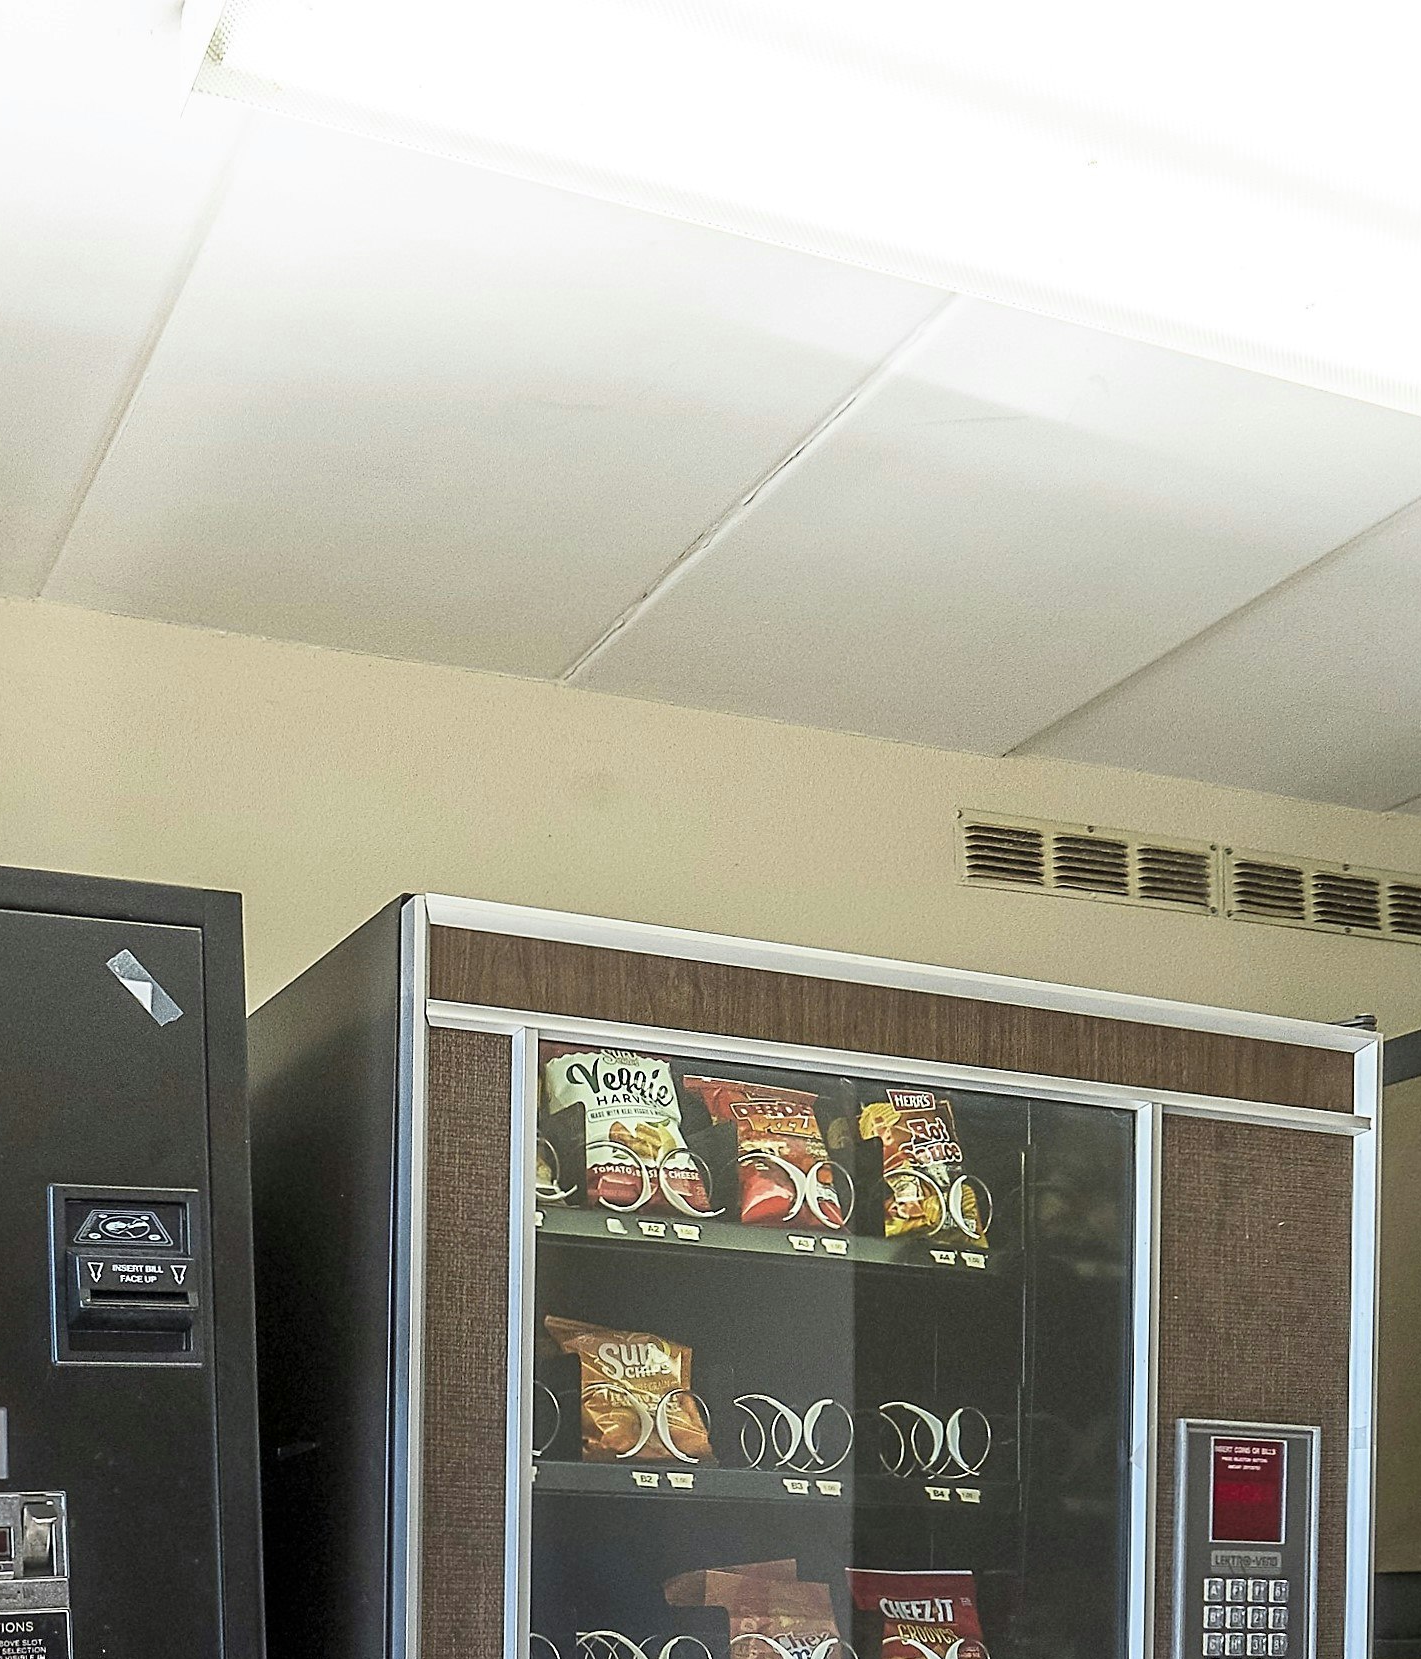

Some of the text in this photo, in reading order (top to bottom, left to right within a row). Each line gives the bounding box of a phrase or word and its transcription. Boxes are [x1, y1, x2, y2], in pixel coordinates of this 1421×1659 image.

[566, 1058, 674, 1106] Veggie
[894, 1094, 931, 1108] HERR'S
[669, 1170, 700, 1180] CHEESE
[647, 1225, 660, 1233] A2
[798, 1239, 810, 1248] A3
[111, 1264, 164, 1274] INSERT BILL
[119, 1274, 158, 1284] FACE UP
[598, 1342, 660, 1381] Sun
[624, 1362, 672, 1378] CHIPS
[640, 1475, 653, 1483] B2
[791, 1481, 803, 1489] B3
[933, 1488, 945, 1496] B4
[2, 1646, 46, 1655] SELECTION
